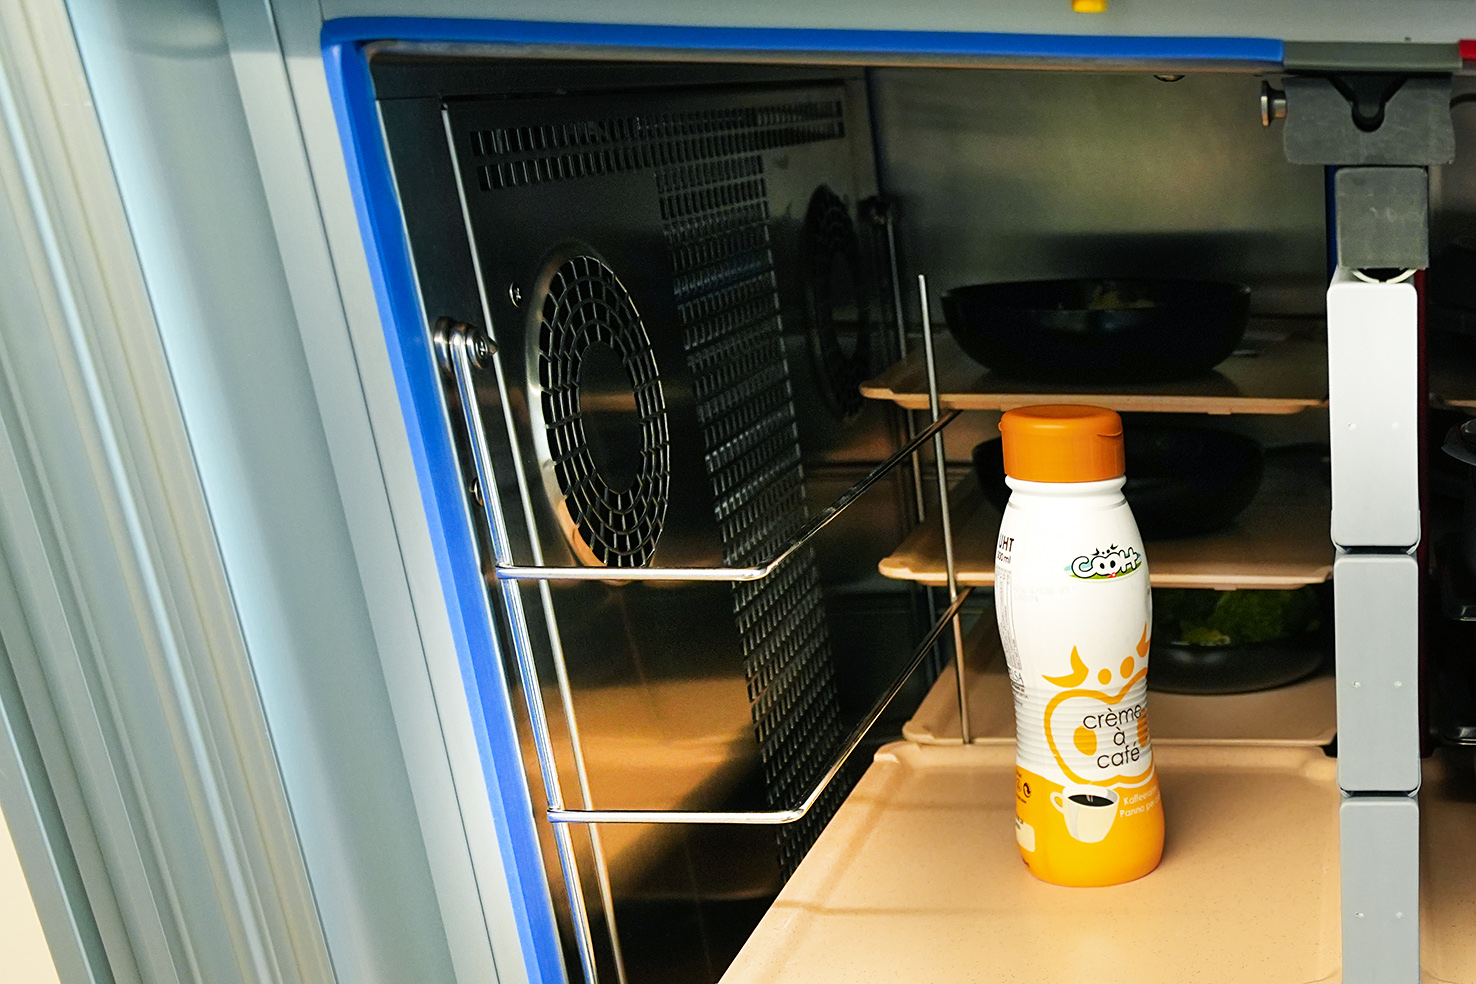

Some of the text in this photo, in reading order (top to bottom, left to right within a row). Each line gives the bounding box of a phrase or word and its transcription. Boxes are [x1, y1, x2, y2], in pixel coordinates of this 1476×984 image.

[1083, 704, 1142, 730] crème
[1113, 727, 1126, 746] à
[1097, 743, 1140, 769] café
[1119, 805, 1146, 819] Panna
